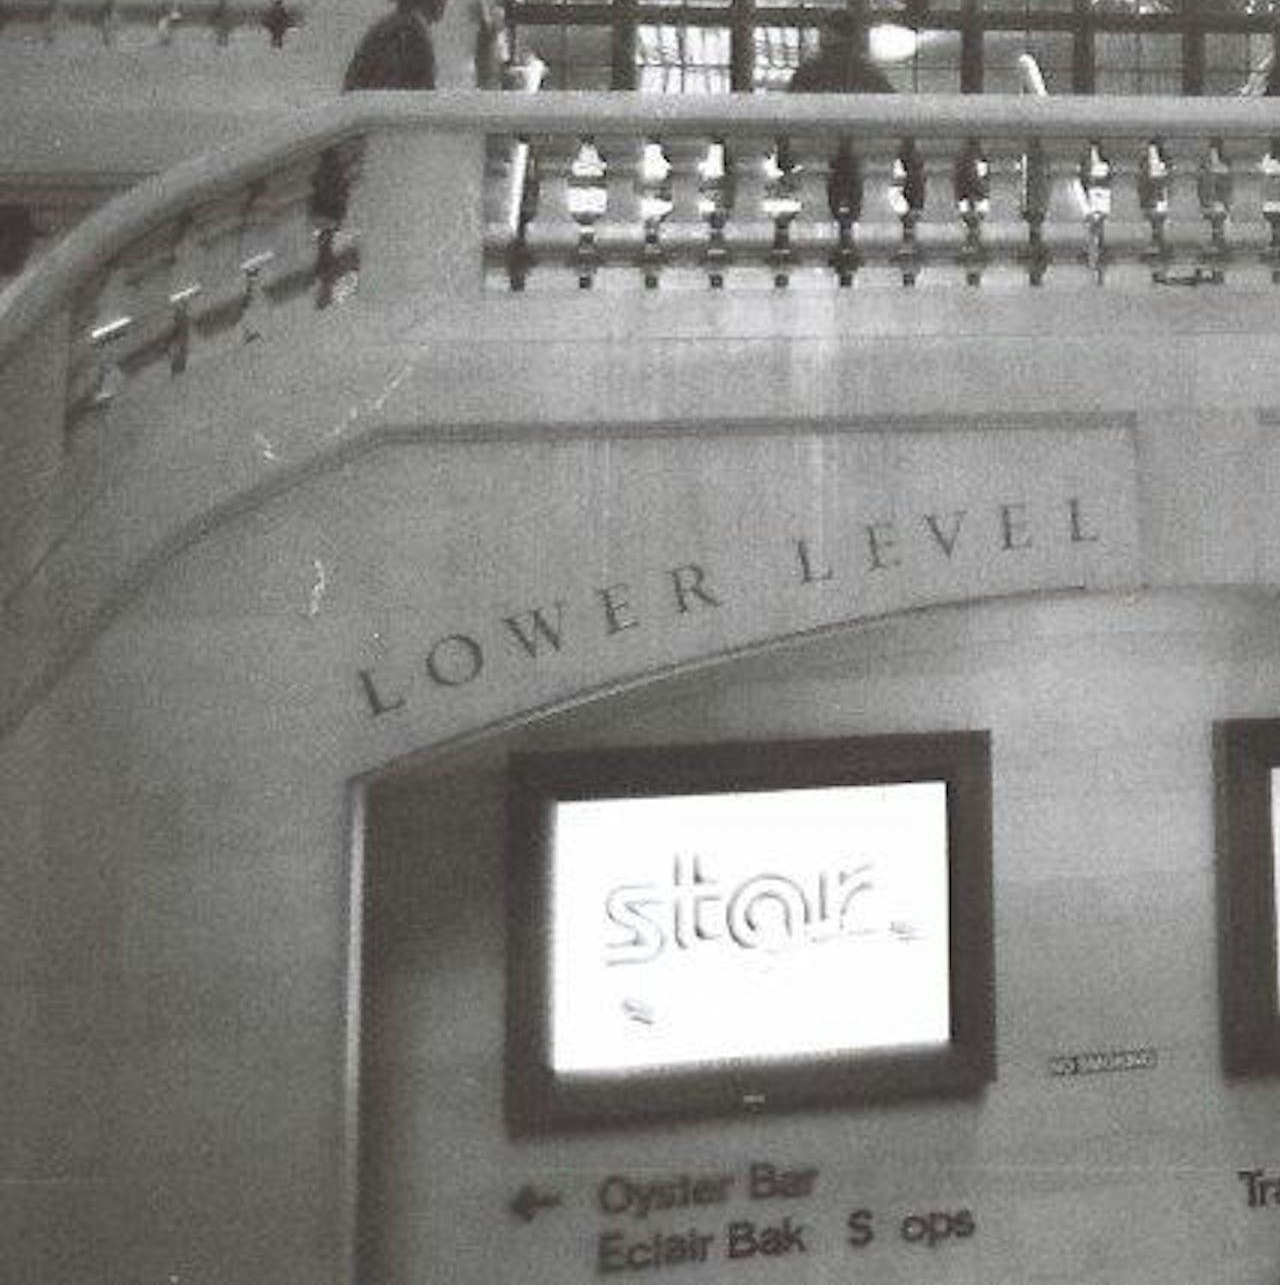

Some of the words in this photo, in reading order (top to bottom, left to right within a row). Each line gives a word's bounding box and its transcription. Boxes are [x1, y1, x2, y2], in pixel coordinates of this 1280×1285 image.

[356, 560, 724, 715] LOWER
[792, 497, 1100, 584] LEVEL
[598, 1173, 737, 1219] Oyster
[750, 1161, 819, 1202] Bar
[598, 1225, 715, 1274] Eclair
